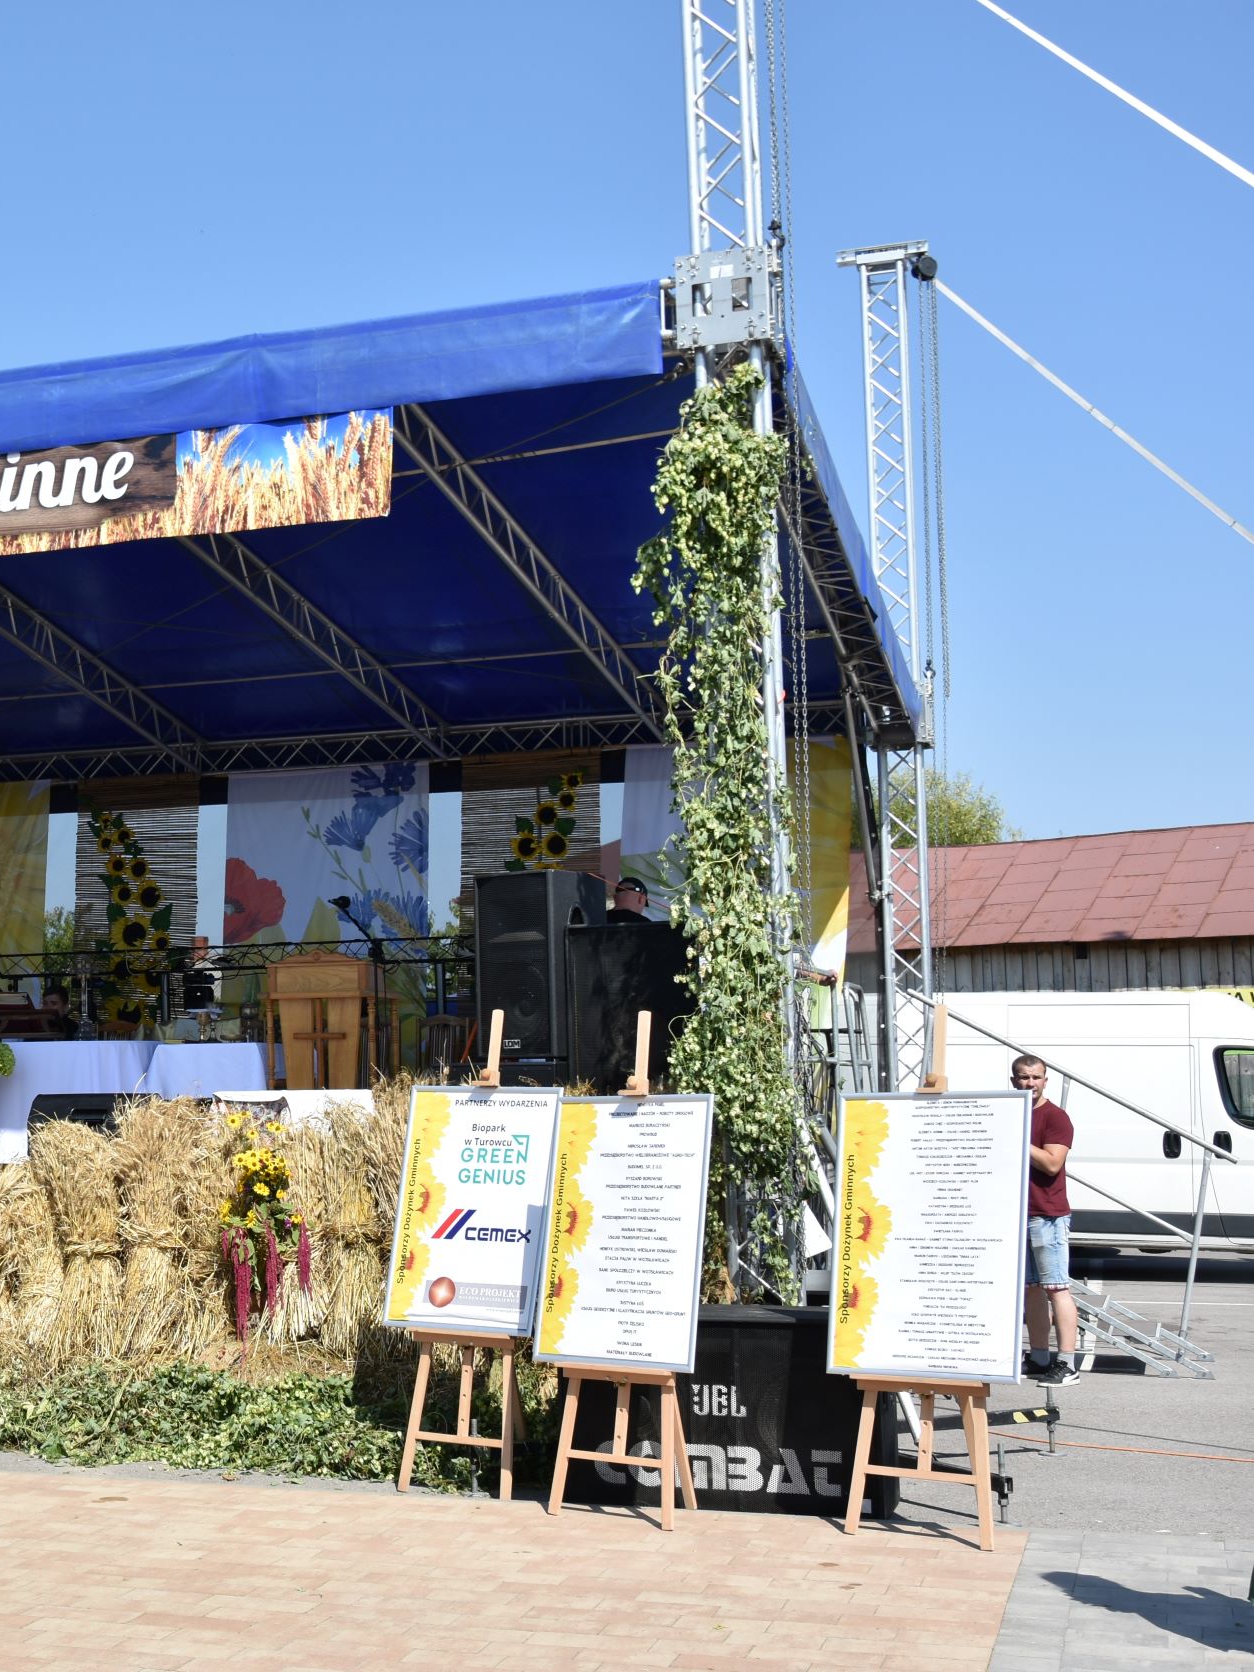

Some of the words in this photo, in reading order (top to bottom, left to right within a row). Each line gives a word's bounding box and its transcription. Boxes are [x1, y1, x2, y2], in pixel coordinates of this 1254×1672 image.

[472, 1124, 506, 1134] Biopark
[475, 1138, 512, 1146] Turowcu
[461, 1143, 529, 1164] GREEN
[458, 1168, 526, 1185] GENIUS
[556, 1153, 567, 1206] Gminnych
[845, 1154, 856, 1210] Gminnych
[397, 1232, 410, 1284] Sponsorzy
[404, 1190, 414, 1230] Dożynek
[409, 1138, 422, 1186] Gminnych
[552, 1210, 562, 1254] Dożynek
[465, 1227, 532, 1243] CEMEX
[843, 1213, 853, 1260] Dożynek
[480, 1288, 521, 1298] PROJEKT
[546, 1257, 558, 1312] Sponsorzy
[840, 1264, 852, 1324] Sponsorzy
[692, 1384, 746, 1417] JBL
[595, 1440, 842, 1497] COMBAT
